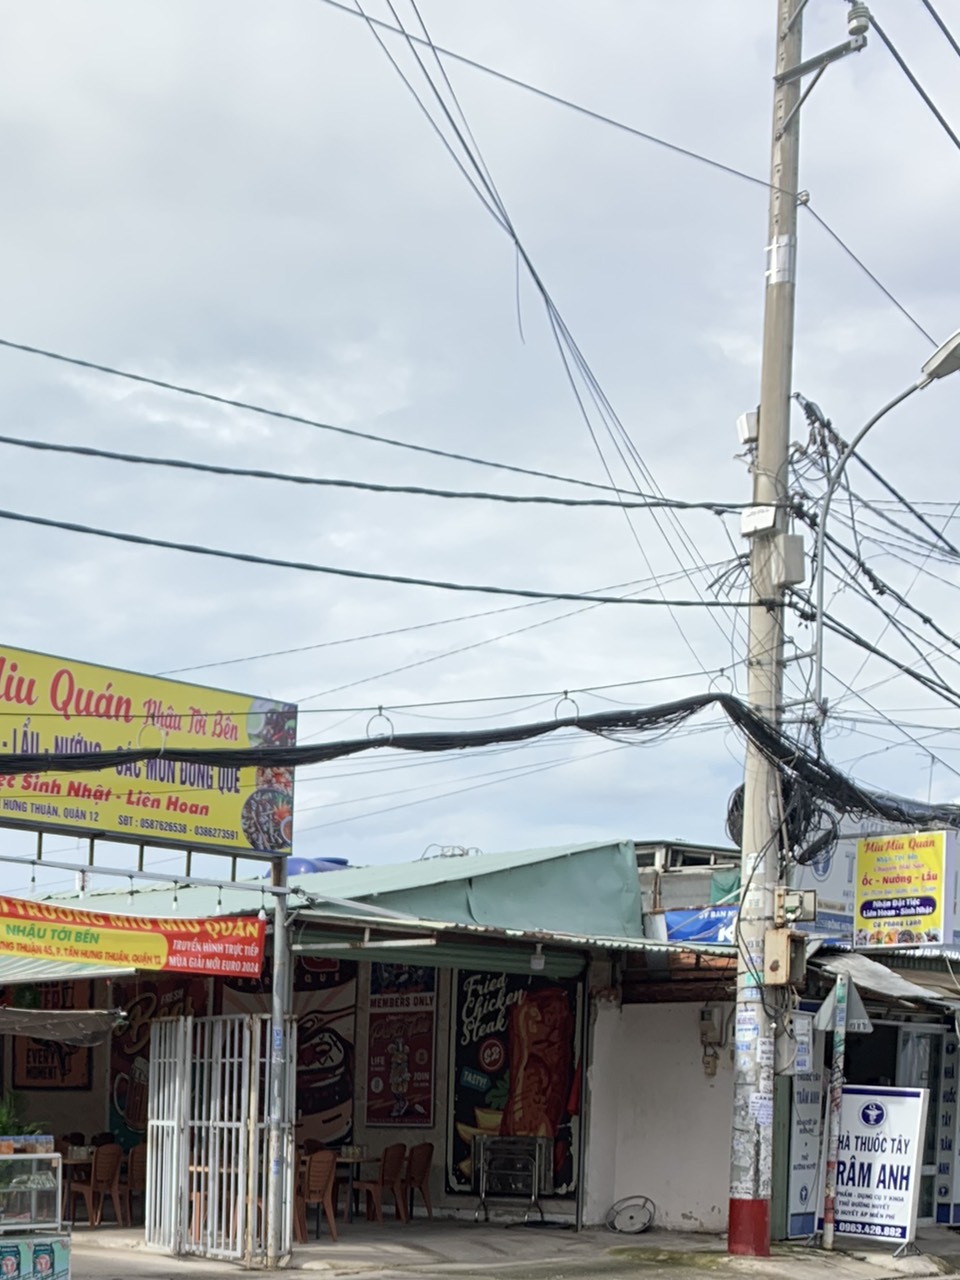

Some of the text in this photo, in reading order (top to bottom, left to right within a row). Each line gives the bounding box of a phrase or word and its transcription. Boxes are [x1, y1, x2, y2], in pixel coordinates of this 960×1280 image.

[50, 669, 134, 724] Quán
[21, 773, 61, 796] Sinh
[67, 780, 112, 806] Nhật
[126, 788, 161, 810] Liên
[166, 796, 209, 816] Hoan
[3, 799, 27, 813] HƯNG
[63, 807, 86, 822] QUẬN
[89, 811, 99, 822] 12
[862, 872, 872, 886] Ốc
[5, 923, 100, 945] NHẬU TỚI BẾN
[17, 941, 43, 957] THUẬN
[63, 946, 76, 959] TÂN
[77, 949, 102, 961] HƯNG
[132, 954, 151, 968] QUẬN
[173, 938, 259, 958] TRUYỀN HÌNH TRỰC TIẾP
[169, 955, 259, 974] MÙA GIẢI MỚI EURO 2024
[463, 972, 508, 1000] Fried
[370, 995, 434, 1009] MEMBERS ONLY
[462, 988, 527, 1022] Chicken
[461, 1008, 508, 1045] Steak
[837, 1130, 910, 1154] HÀ THUỐC TÂY
[836, 1155, 911, 1191] RÂM ANH
